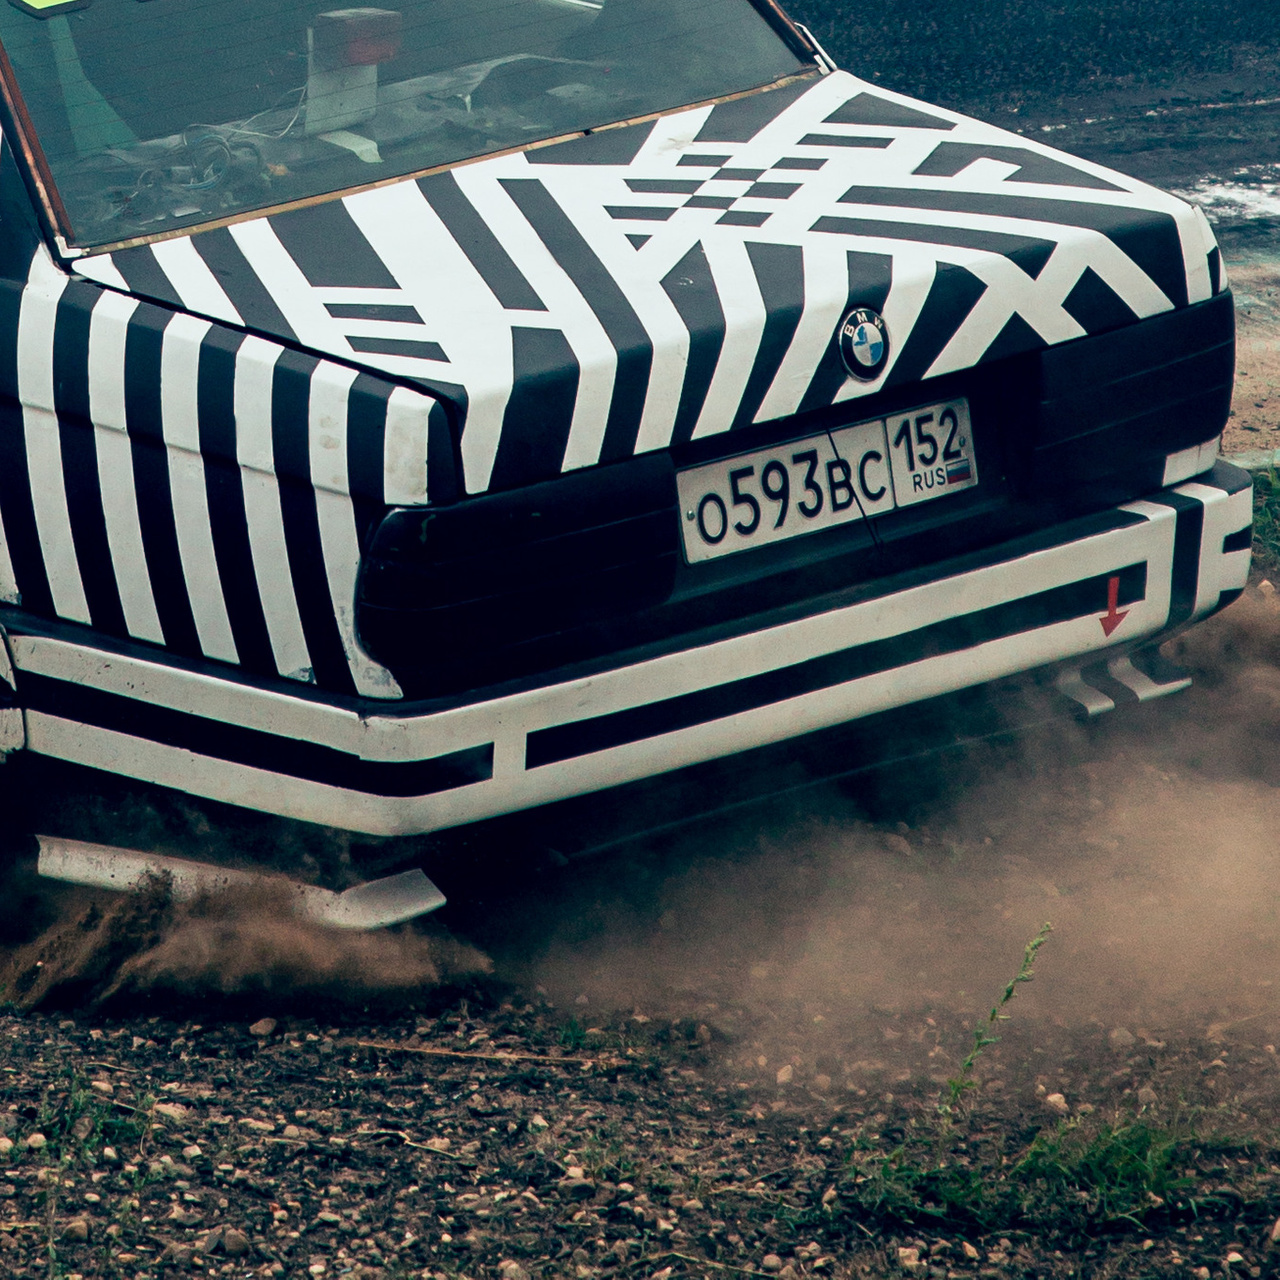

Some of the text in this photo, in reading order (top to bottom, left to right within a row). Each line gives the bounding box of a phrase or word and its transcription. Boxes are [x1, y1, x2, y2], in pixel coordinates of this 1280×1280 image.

[843, 311, 884, 338] BMW
[894, 408, 961, 472] 152
[912, 466, 947, 493] RUS
